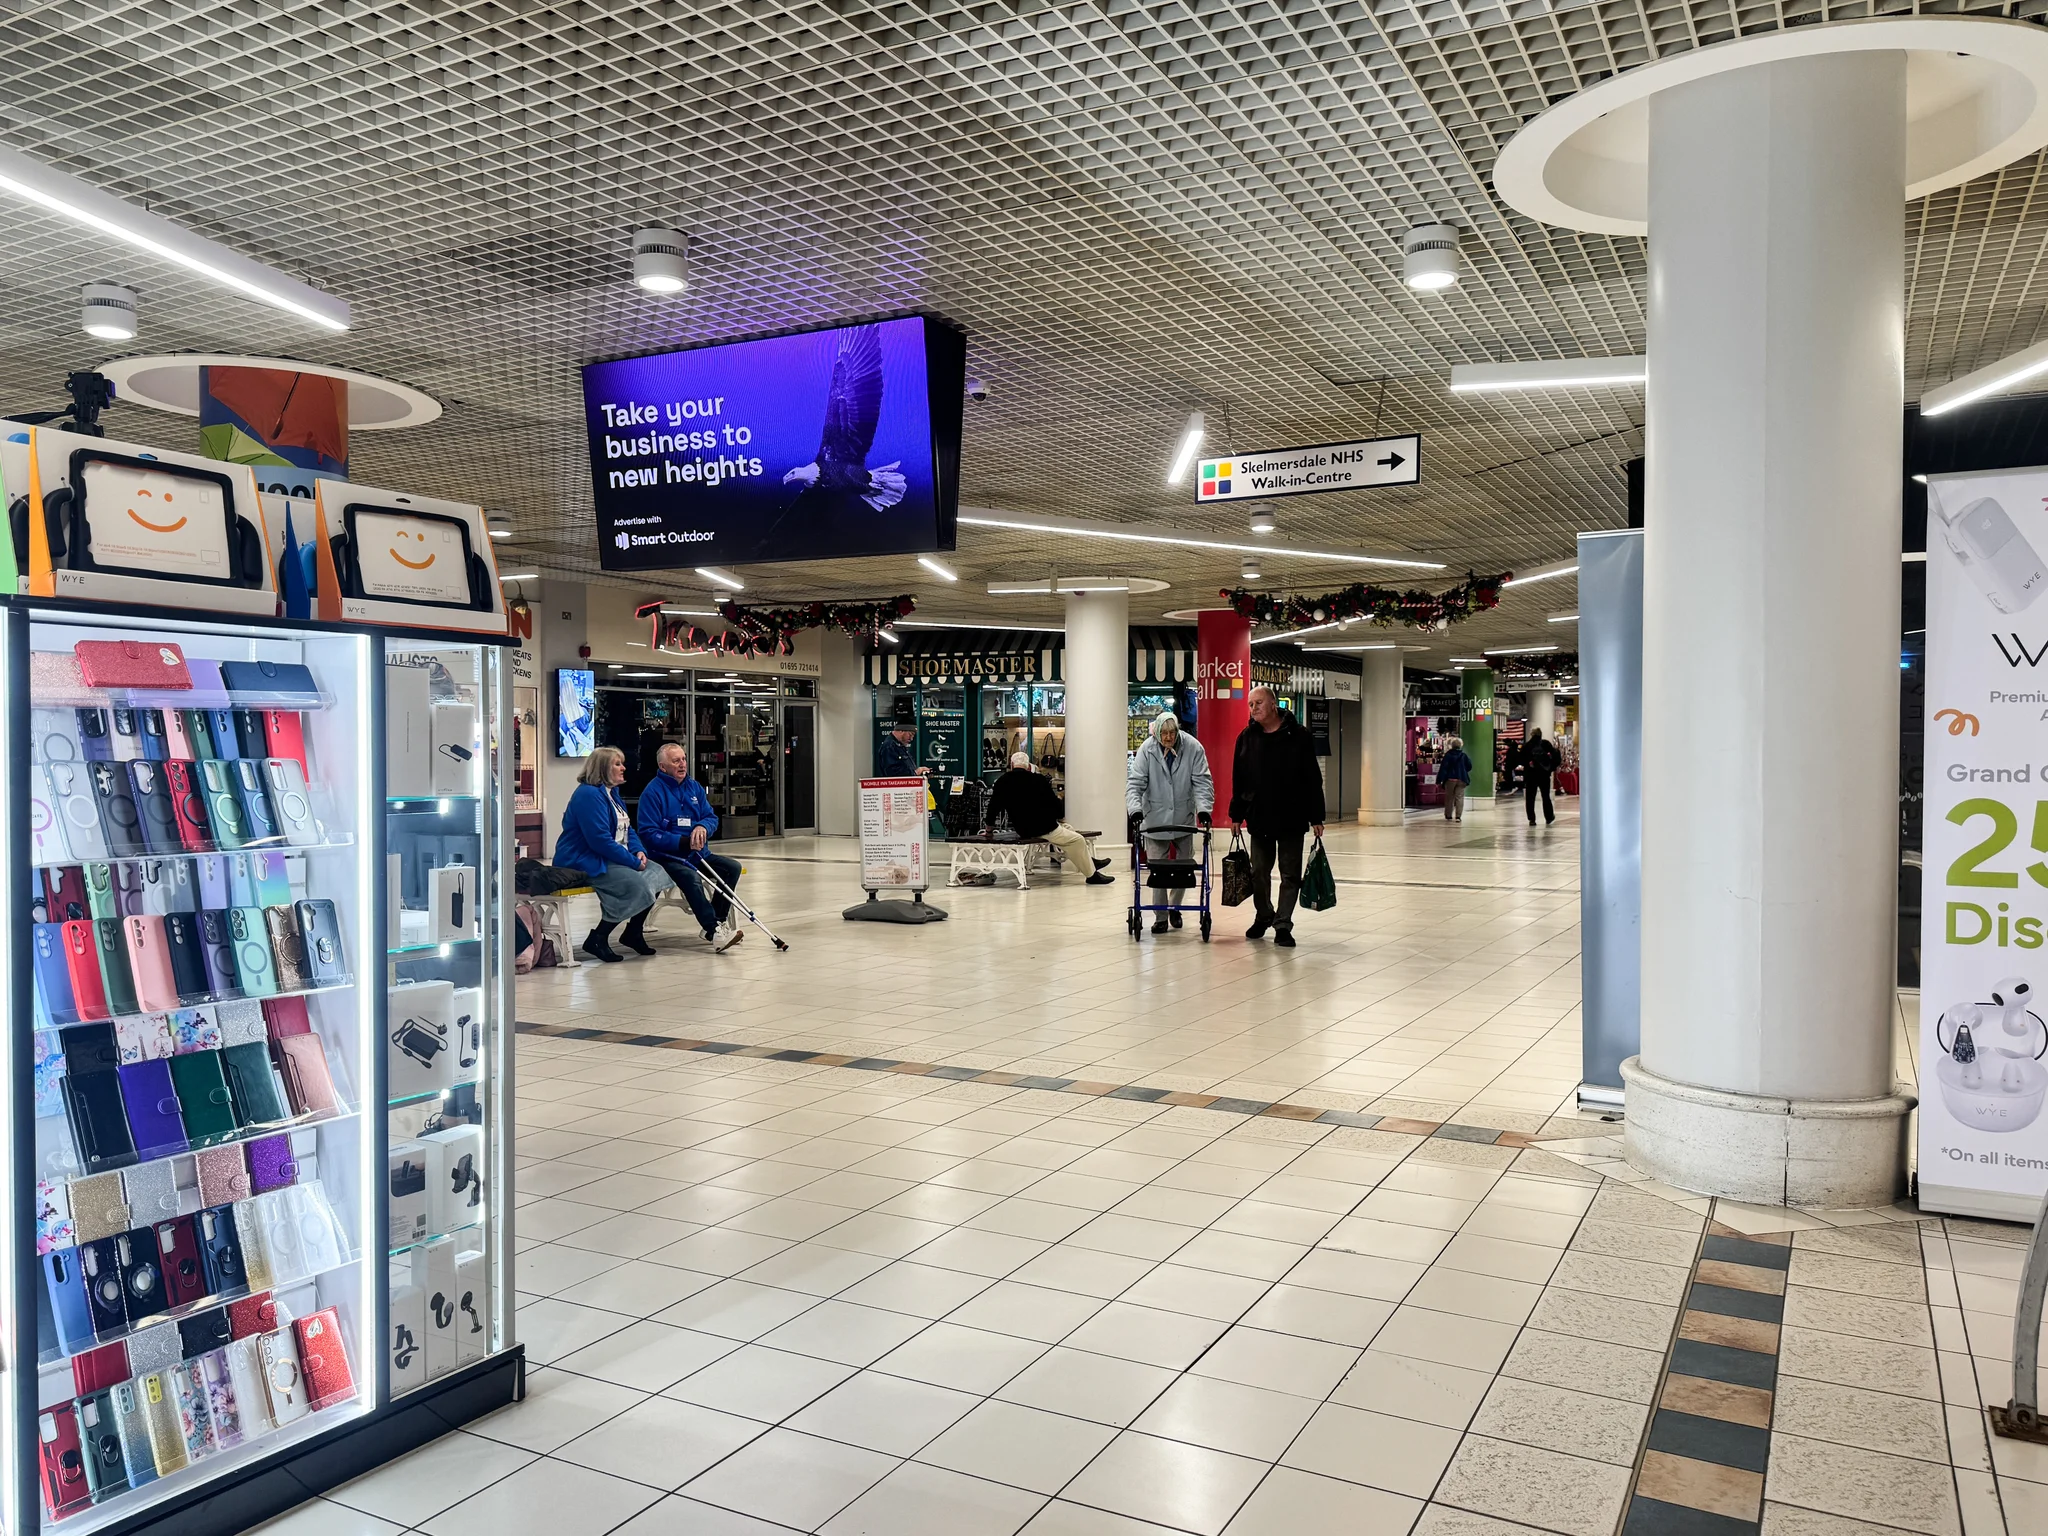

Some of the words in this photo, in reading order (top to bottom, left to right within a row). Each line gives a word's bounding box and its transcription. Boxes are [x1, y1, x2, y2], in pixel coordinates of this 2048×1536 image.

[601, 402, 659, 428] Take
[666, 395, 724, 428] your
[605, 429, 716, 459] business
[722, 421, 752, 447] to
[1241, 455, 1327, 474] Skelmersdale
[1331, 450, 1364, 465] NHS
[609, 466, 659, 489] new
[665, 454, 763, 486] heights
[1251, 472, 1352, 489] Walk-in-Centre
[614, 517, 645, 526] Advertise
[646, 515, 662, 524] with
[631, 531, 667, 546] Smart
[668, 529, 715, 544] Outdoor
[61, 574, 85, 585] WYE
[2023, 571, 2041, 590] WYE
[346, 606, 366, 615] WYE
[512, 658, 521, 667] ND
[780, 662, 798, 671] 01695
[798, 663, 819, 672] 721414
[899, 656, 1037, 676] SHOEMASTER
[1197, 679, 1214, 700] all
[1421, 699, 1429, 707] HE
[1461, 709, 1474, 721] all
[1947, 764, 2030, 783] Grand
[1946, 902, 2048, 949] Dis
[1976, 1107, 2007, 1117] WYE
[1980, 1152, 1998, 1165] all
